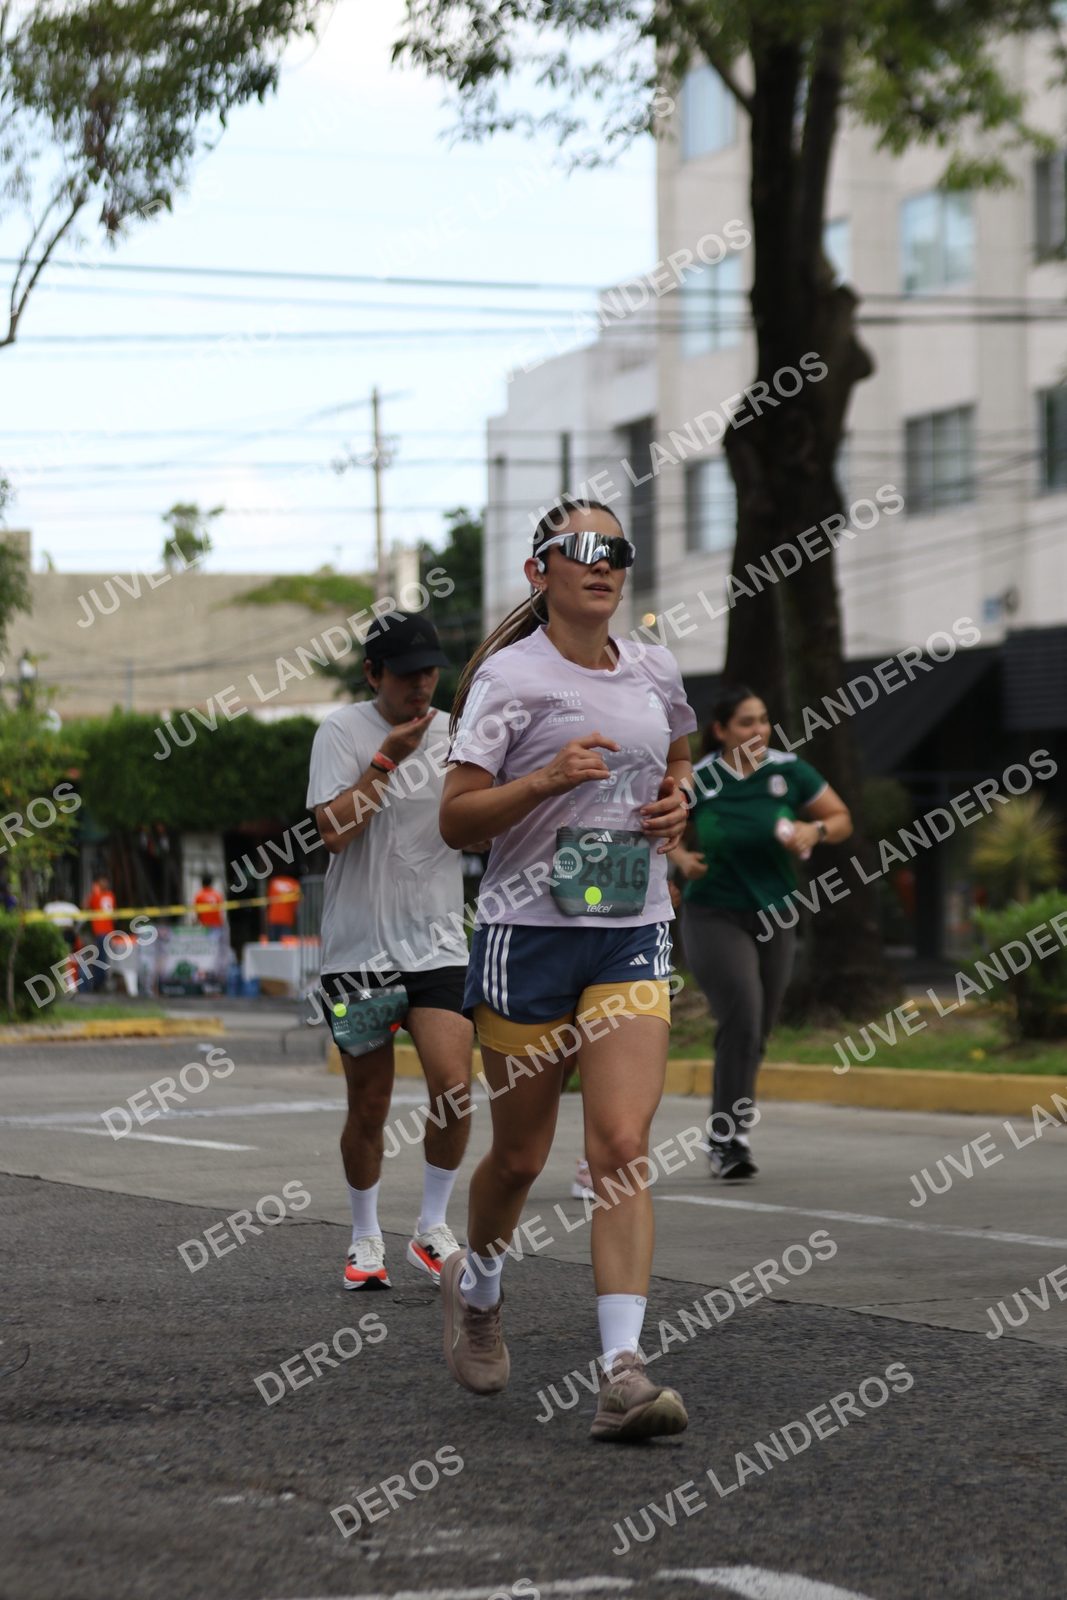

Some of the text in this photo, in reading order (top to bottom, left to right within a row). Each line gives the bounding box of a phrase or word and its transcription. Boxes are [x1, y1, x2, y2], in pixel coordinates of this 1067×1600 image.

[547, 715, 585, 723] SAMSUNG
[578, 855, 646, 890] 2816
[586, 904, 613, 913] telcel
